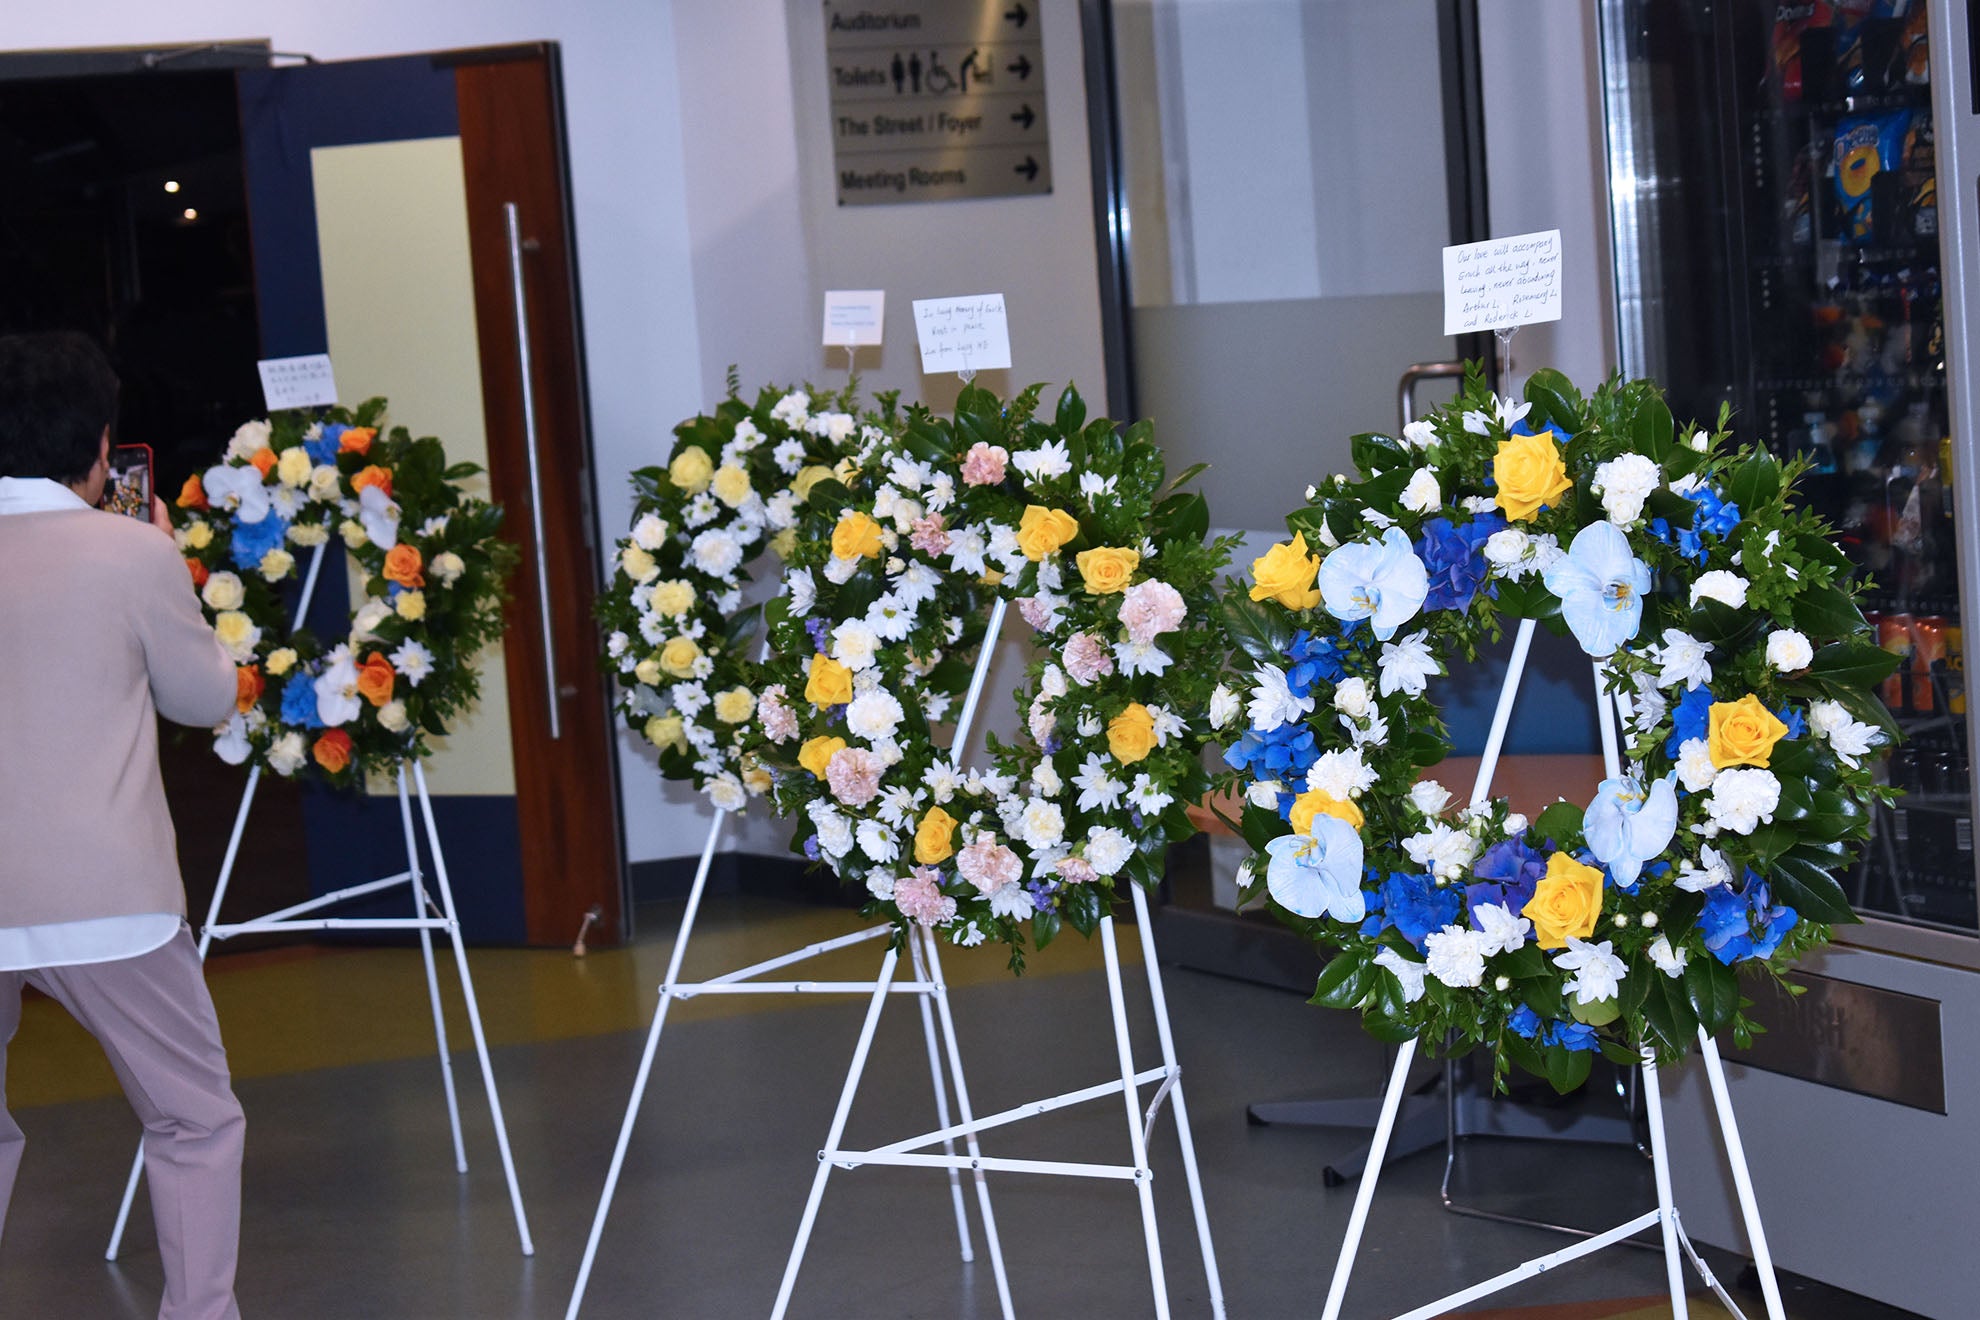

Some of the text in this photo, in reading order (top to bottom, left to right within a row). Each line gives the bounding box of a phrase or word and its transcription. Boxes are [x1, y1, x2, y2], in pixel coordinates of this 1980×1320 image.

[831, 13, 921, 31] Auditorium
[834, 67, 886, 88] Toilets
[838, 117, 868, 136] The
[873, 114, 923, 135] Street
[938, 112, 982, 135] Foyer
[841, 167, 966, 192] Meeting Rooms
[1458, 249, 1471, 264] Our
[1474, 247, 1488, 260] love
[1494, 243, 1509, 256] will
[1498, 260, 1513, 273] the
